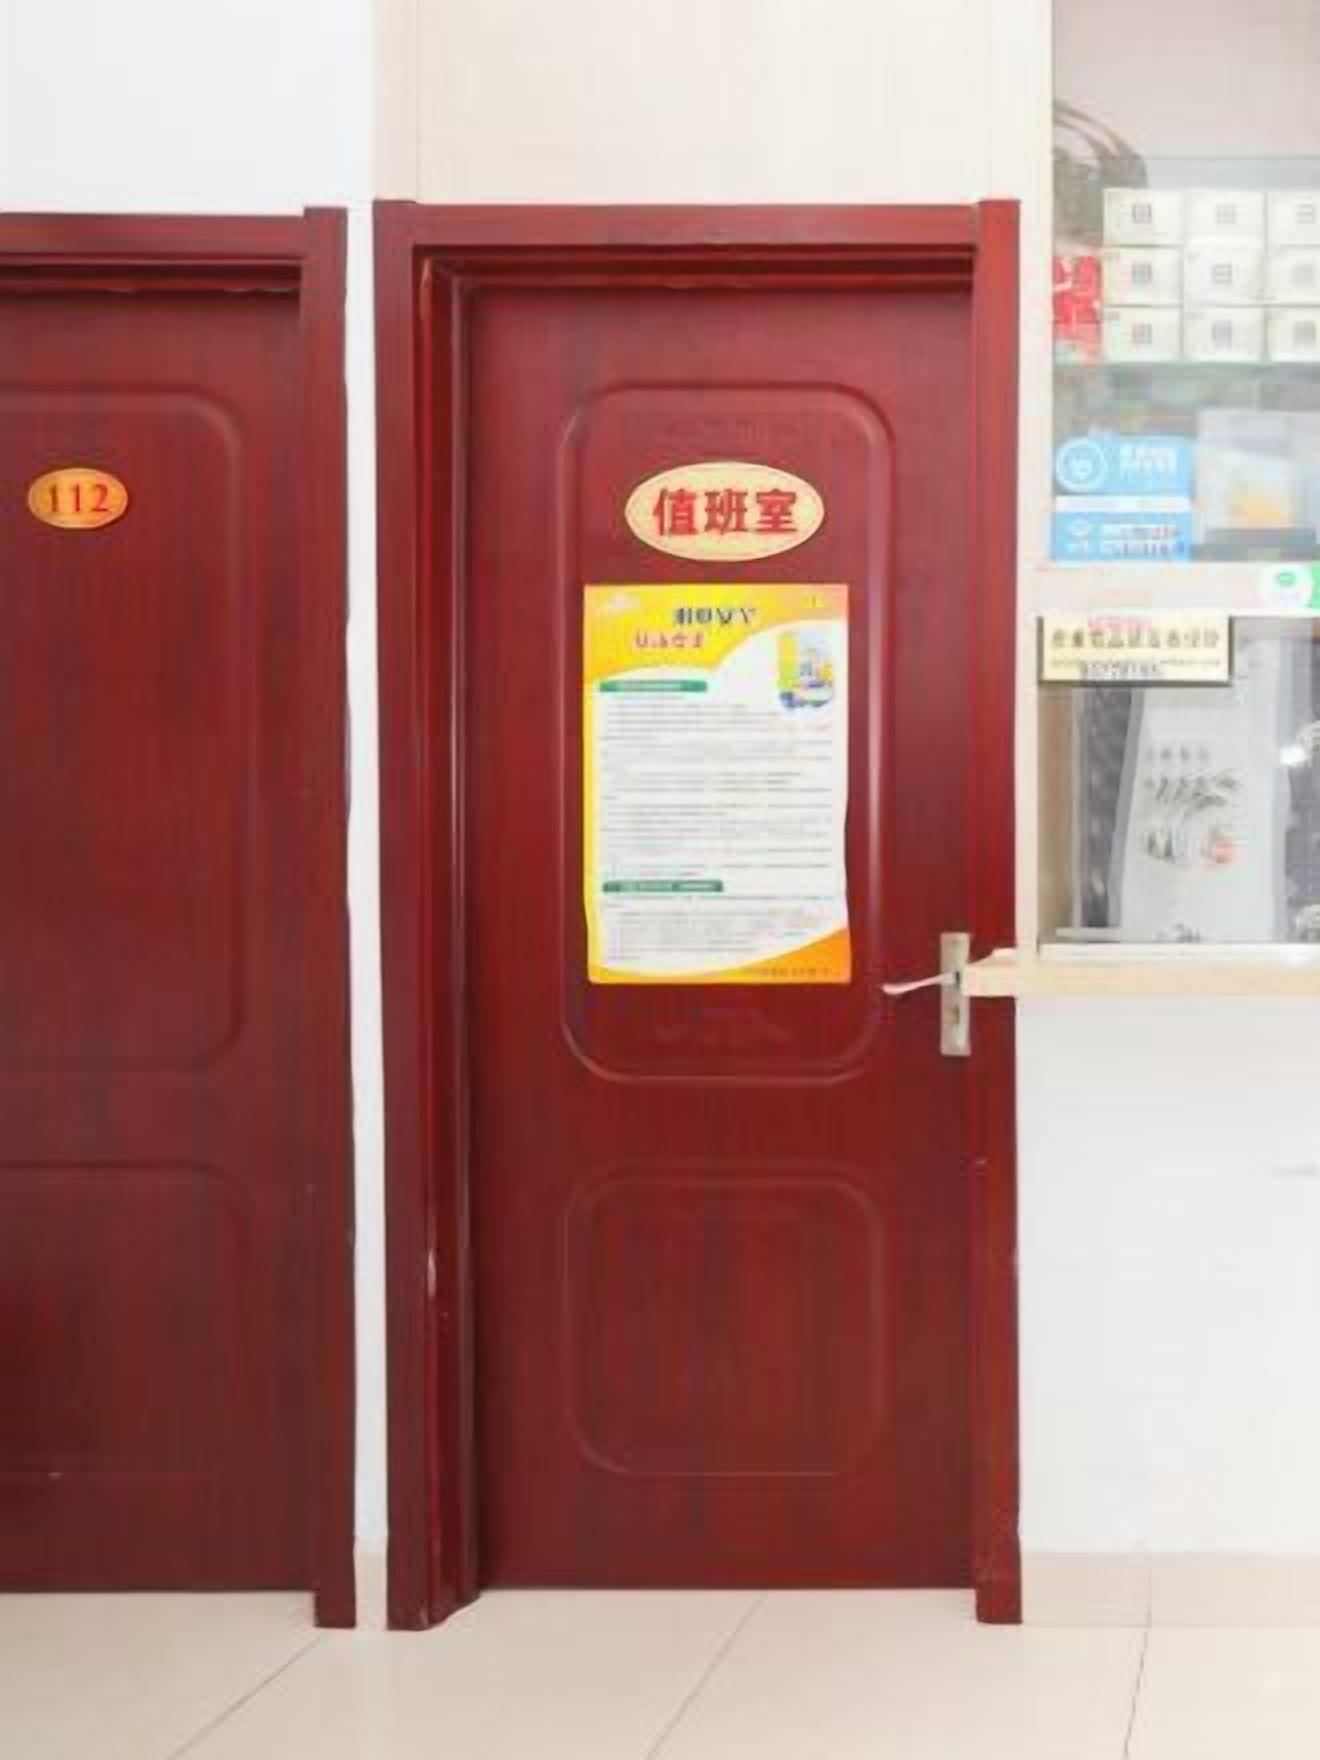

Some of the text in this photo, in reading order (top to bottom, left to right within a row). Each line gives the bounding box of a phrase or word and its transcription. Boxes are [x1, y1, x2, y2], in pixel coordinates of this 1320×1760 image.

[48, 483, 109, 512] 112
[653, 488, 798, 536] 值班室
